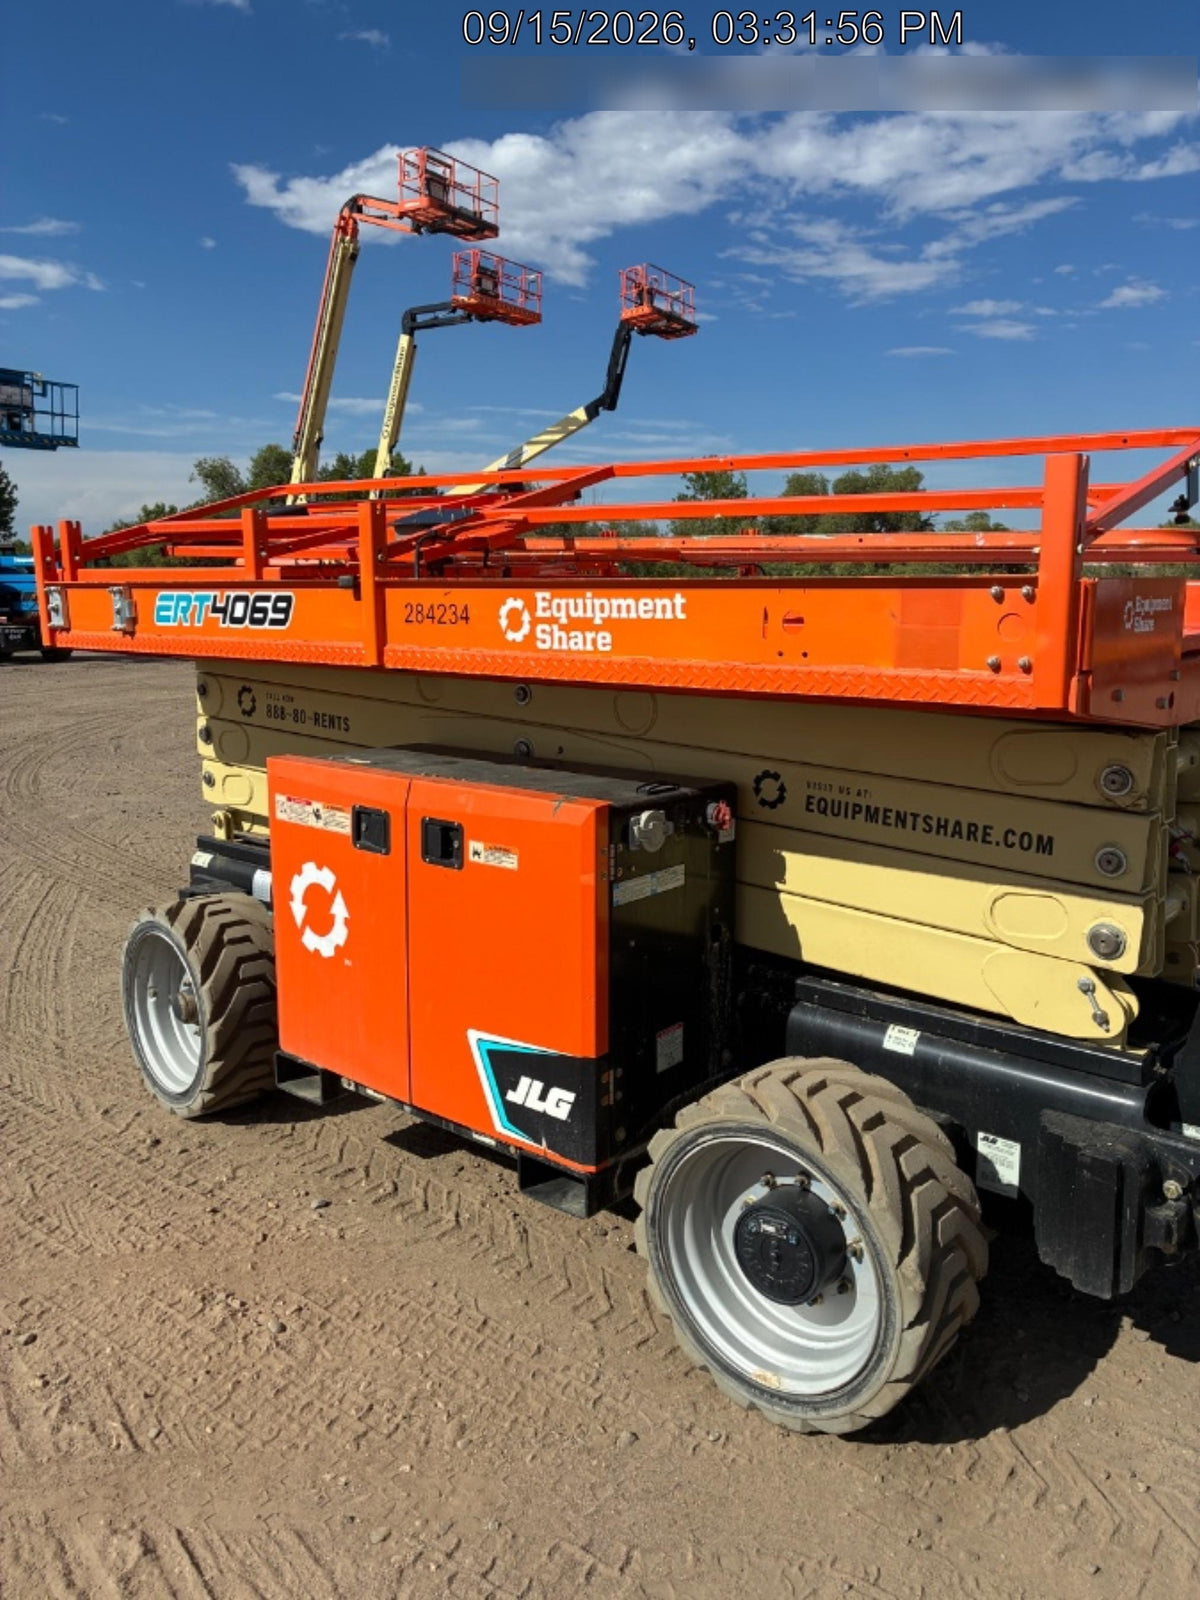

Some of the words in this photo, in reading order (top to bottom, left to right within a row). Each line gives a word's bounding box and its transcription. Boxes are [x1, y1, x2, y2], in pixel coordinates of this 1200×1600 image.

[154, 592, 294, 628] ERT4069
[404, 602, 470, 625] 284234
[535, 592, 687, 625] Equipment
[535, 624, 612, 651] Share
[265, 703, 351, 732] 888-80-RENTS
[806, 781, 833, 793] VISIT
[837, 785, 852, 796] US
[804, 795, 1055, 856] EQUIPMENTSHARE.COM
[505, 1075, 577, 1121] JLG
